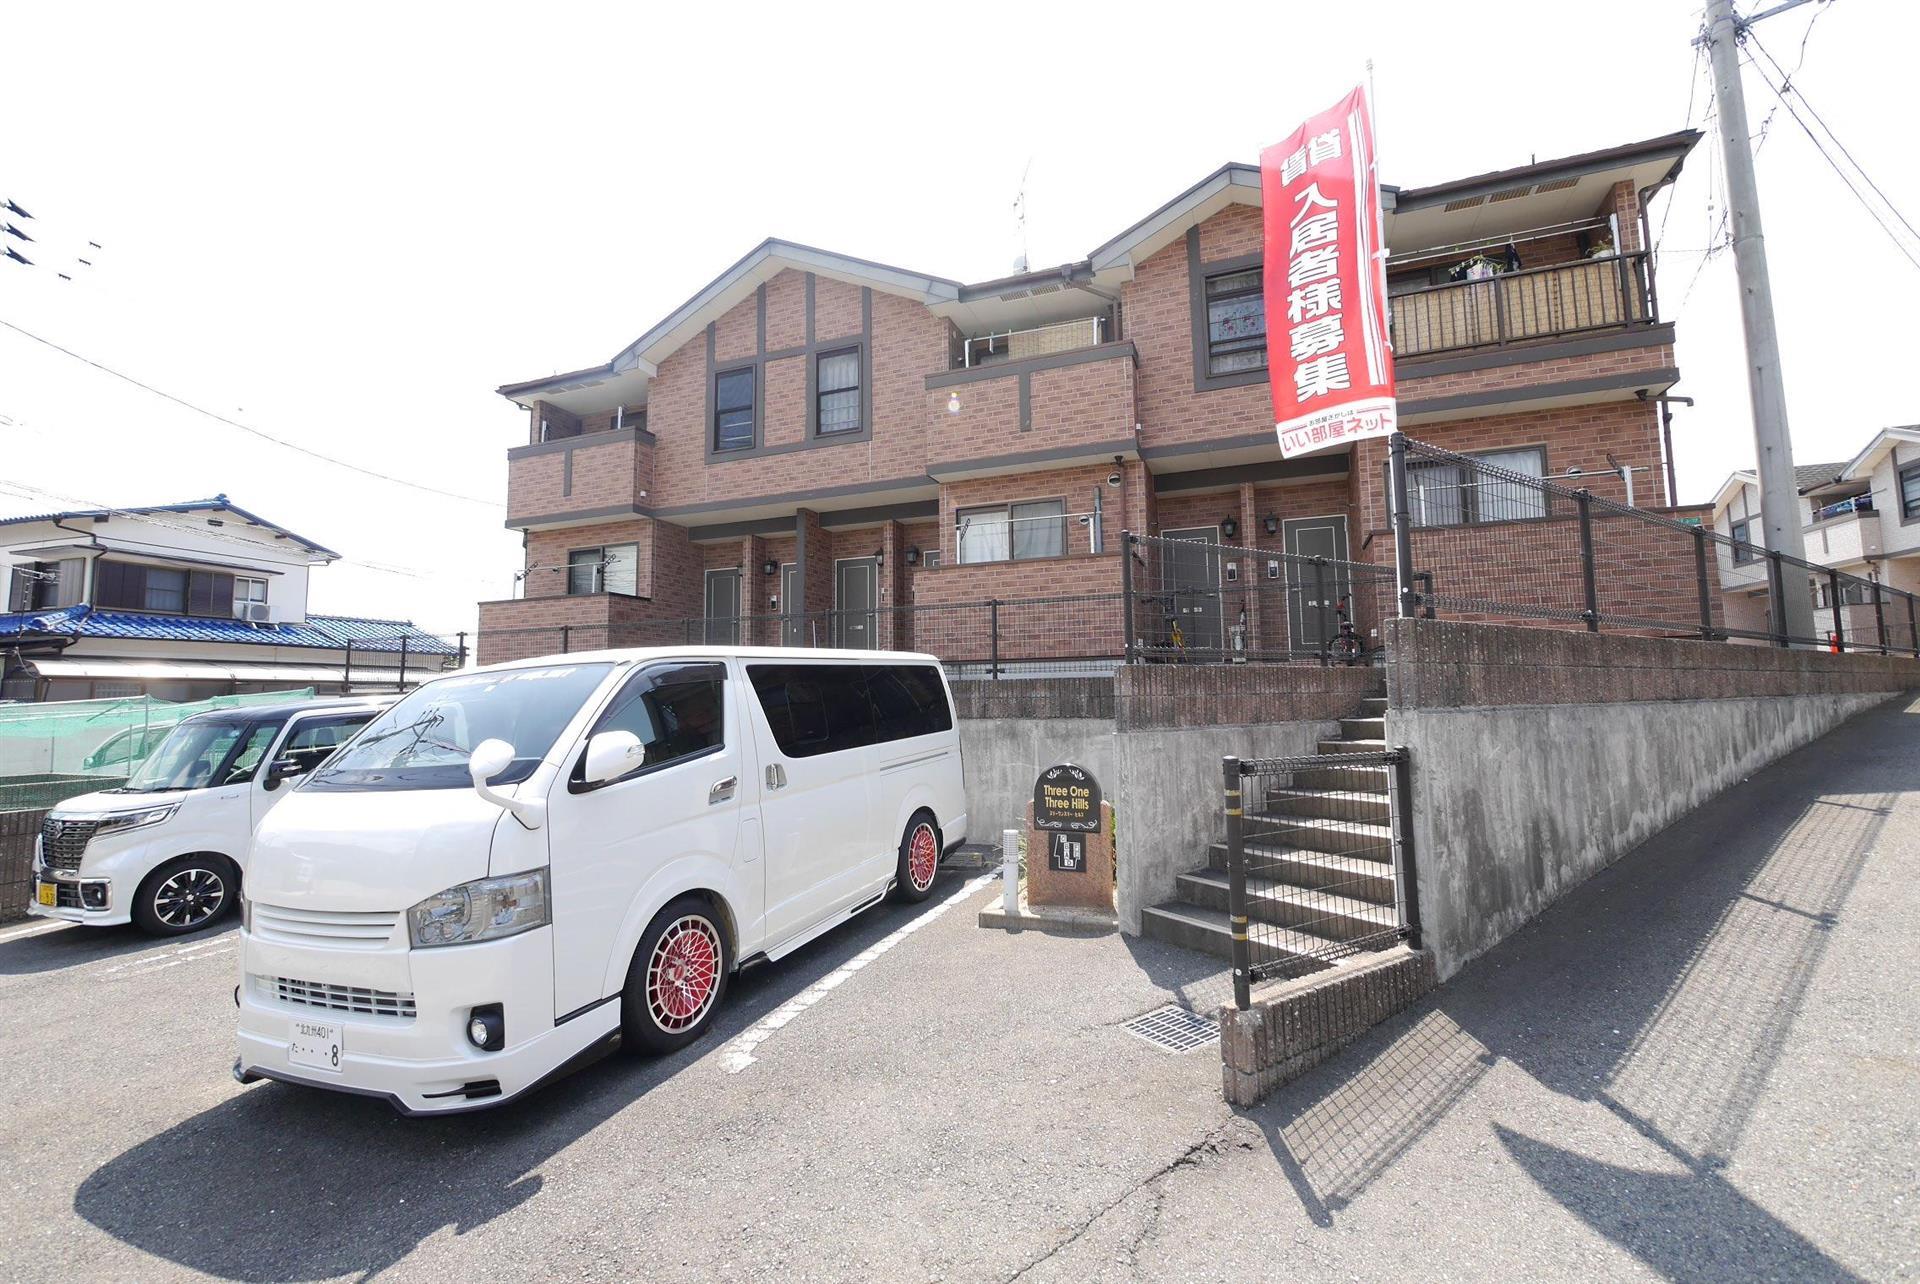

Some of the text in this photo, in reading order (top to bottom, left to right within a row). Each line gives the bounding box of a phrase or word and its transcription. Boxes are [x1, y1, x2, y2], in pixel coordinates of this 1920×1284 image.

[1280, 127, 1343, 188] 賃貸
[1287, 181, 1351, 403] 入居者様募集
[1282, 413, 1392, 452] いい部屋ネット
[1044, 785, 1090, 797] Three One
[1045, 797, 1089, 810] Three Hills
